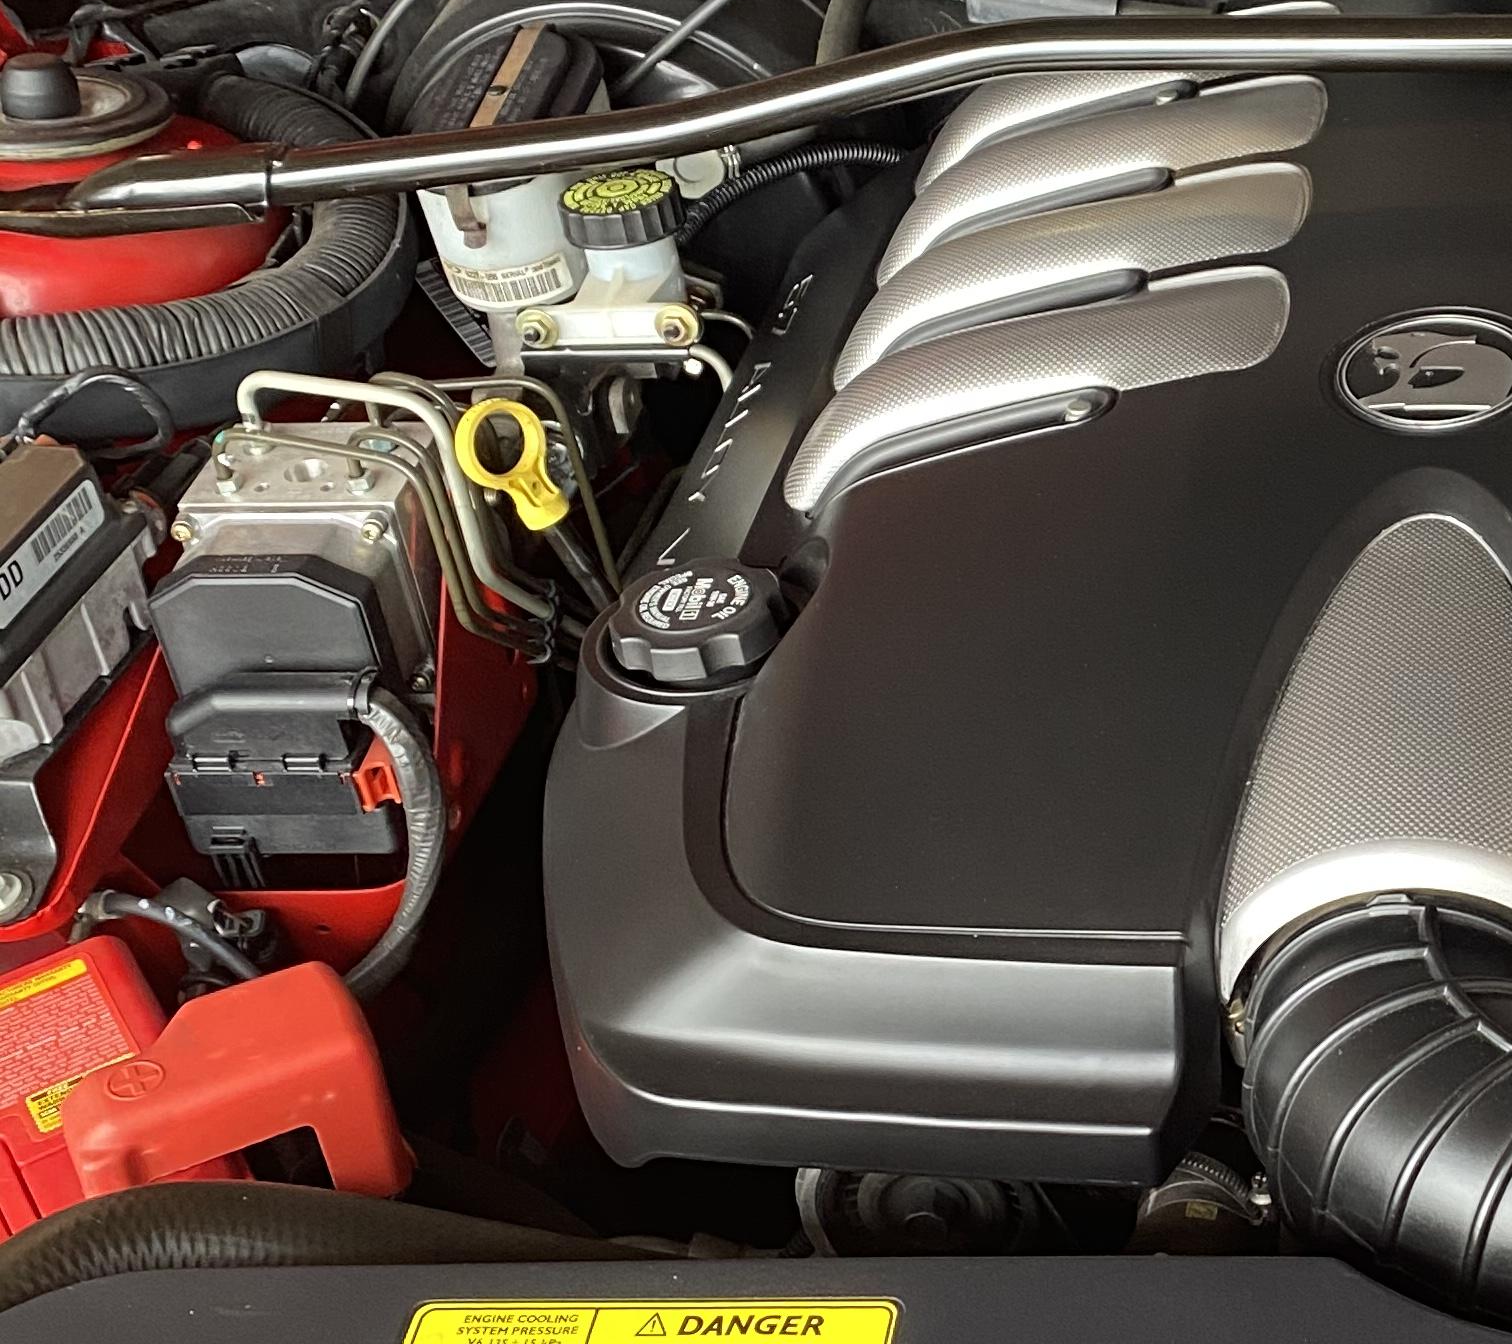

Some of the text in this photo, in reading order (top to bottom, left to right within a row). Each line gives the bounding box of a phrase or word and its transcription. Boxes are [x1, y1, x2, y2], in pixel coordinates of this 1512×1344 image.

[688, 362, 772, 502] ALLOY
[685, 578, 713, 609] Mobil
[727, 575, 749, 606] ENGINE
[711, 606, 736, 619] OIL
[464, 1315, 579, 1323] ENGINE COOLING
[677, 1316, 824, 1336] DANGER
[457, 1326, 578, 1335] SYSTEM PRESSURE
